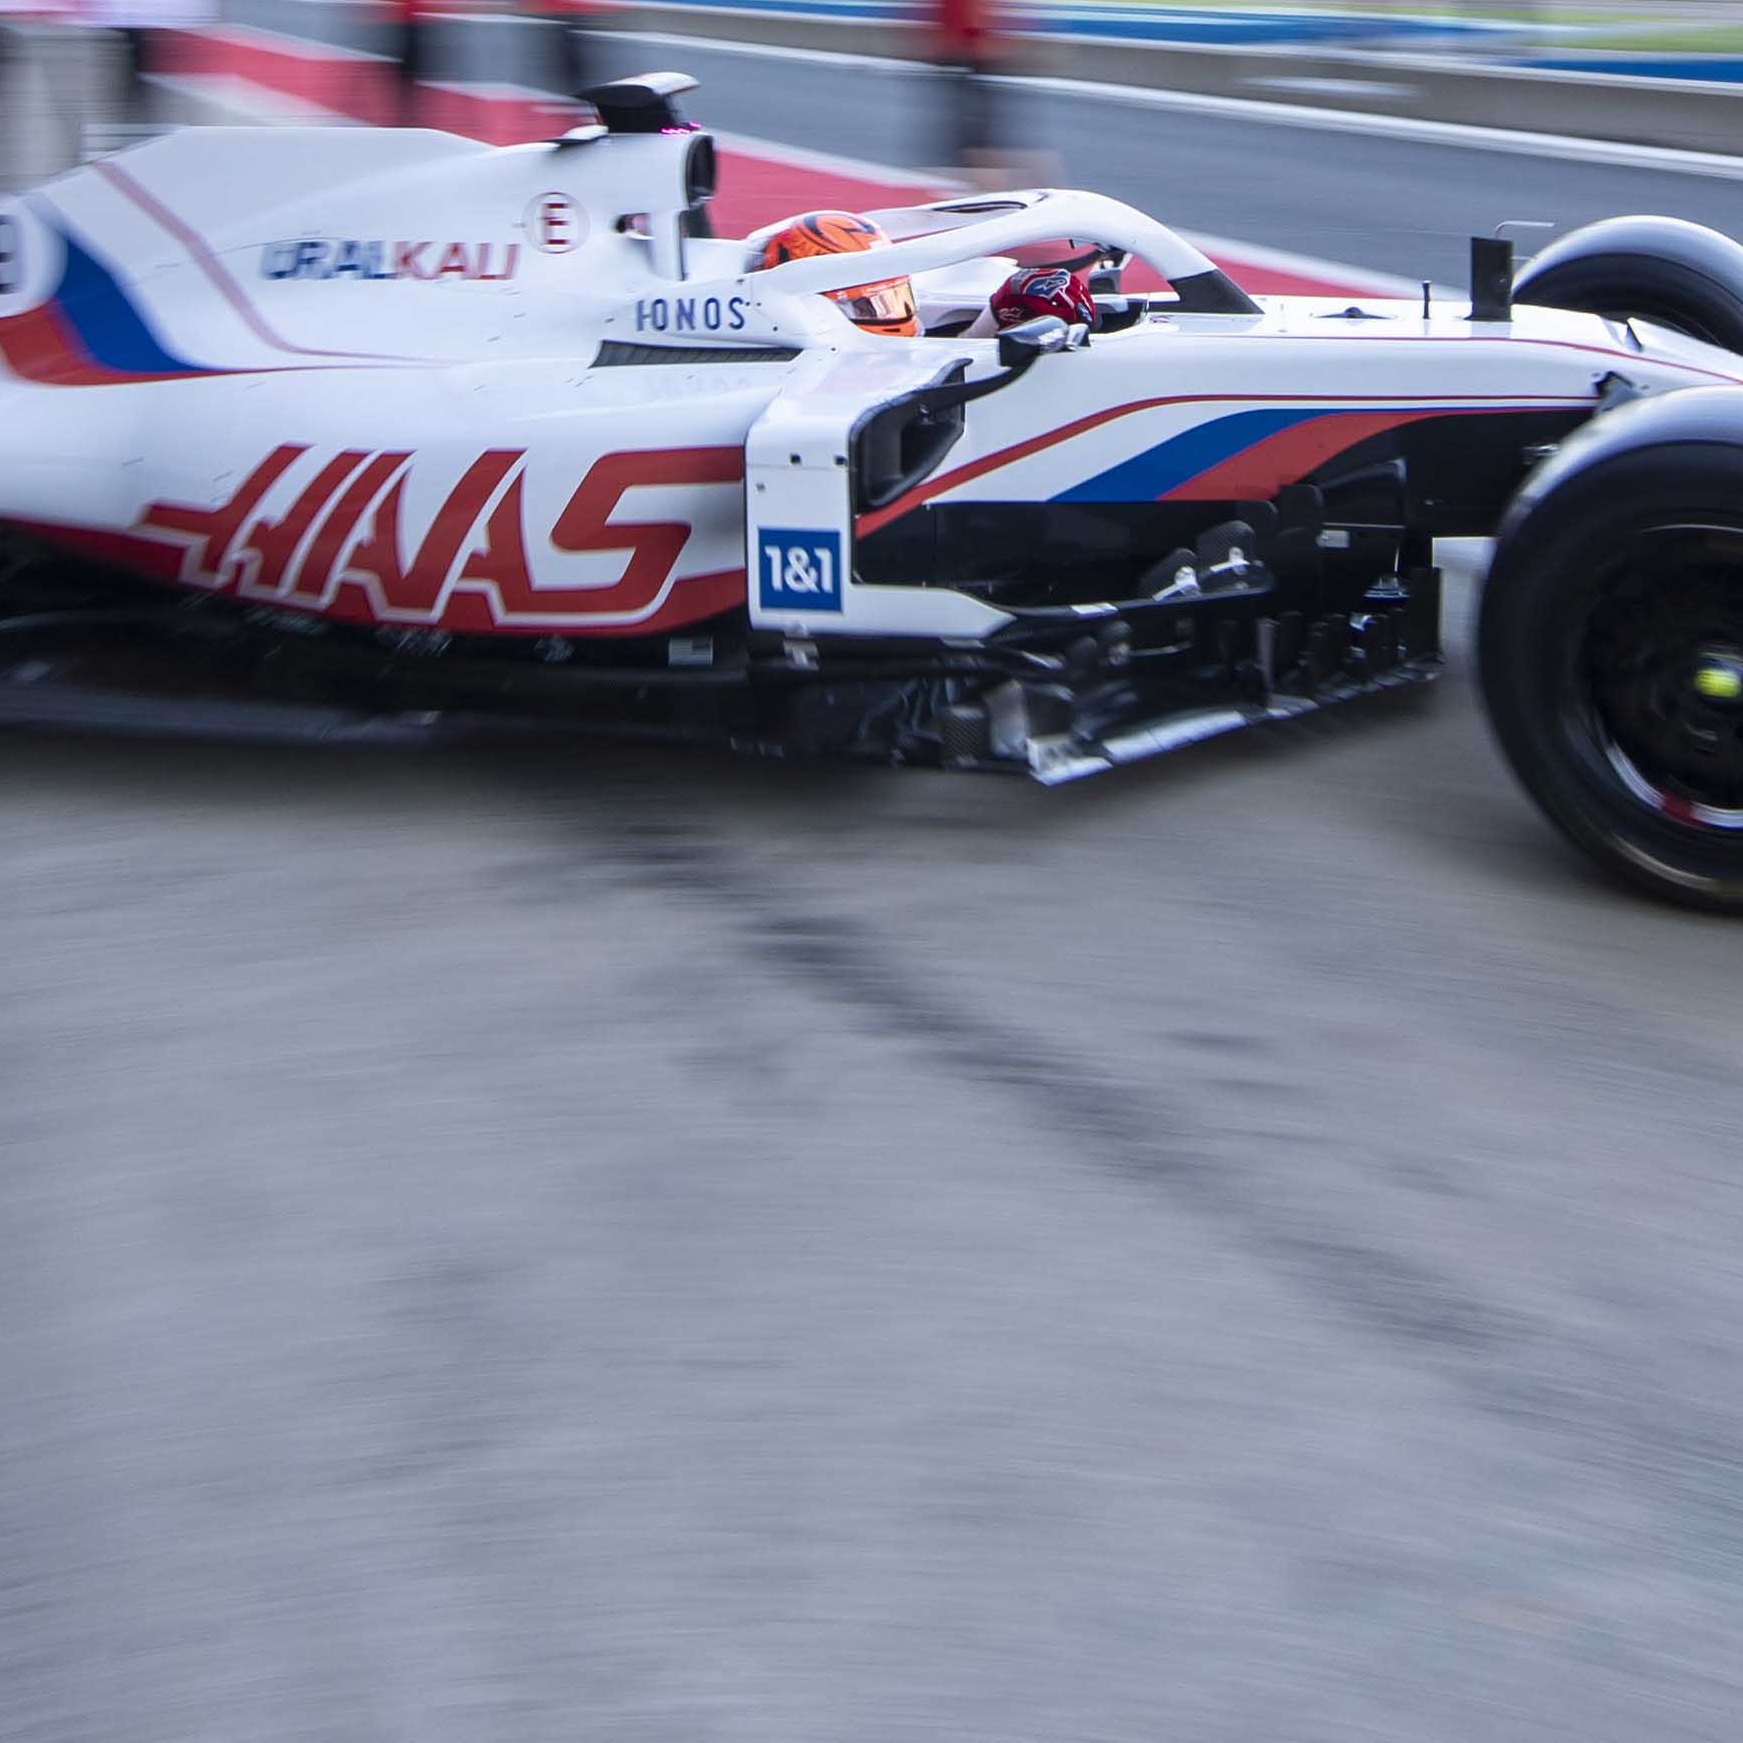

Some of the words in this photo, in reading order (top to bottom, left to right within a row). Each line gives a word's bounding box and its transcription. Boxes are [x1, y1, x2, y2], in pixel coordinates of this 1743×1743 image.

[541, 202, 570, 245] E
[636, 296, 746, 332] IONOS
[134, 443, 746, 626] HAAS
[764, 545, 834, 594] 1&1
